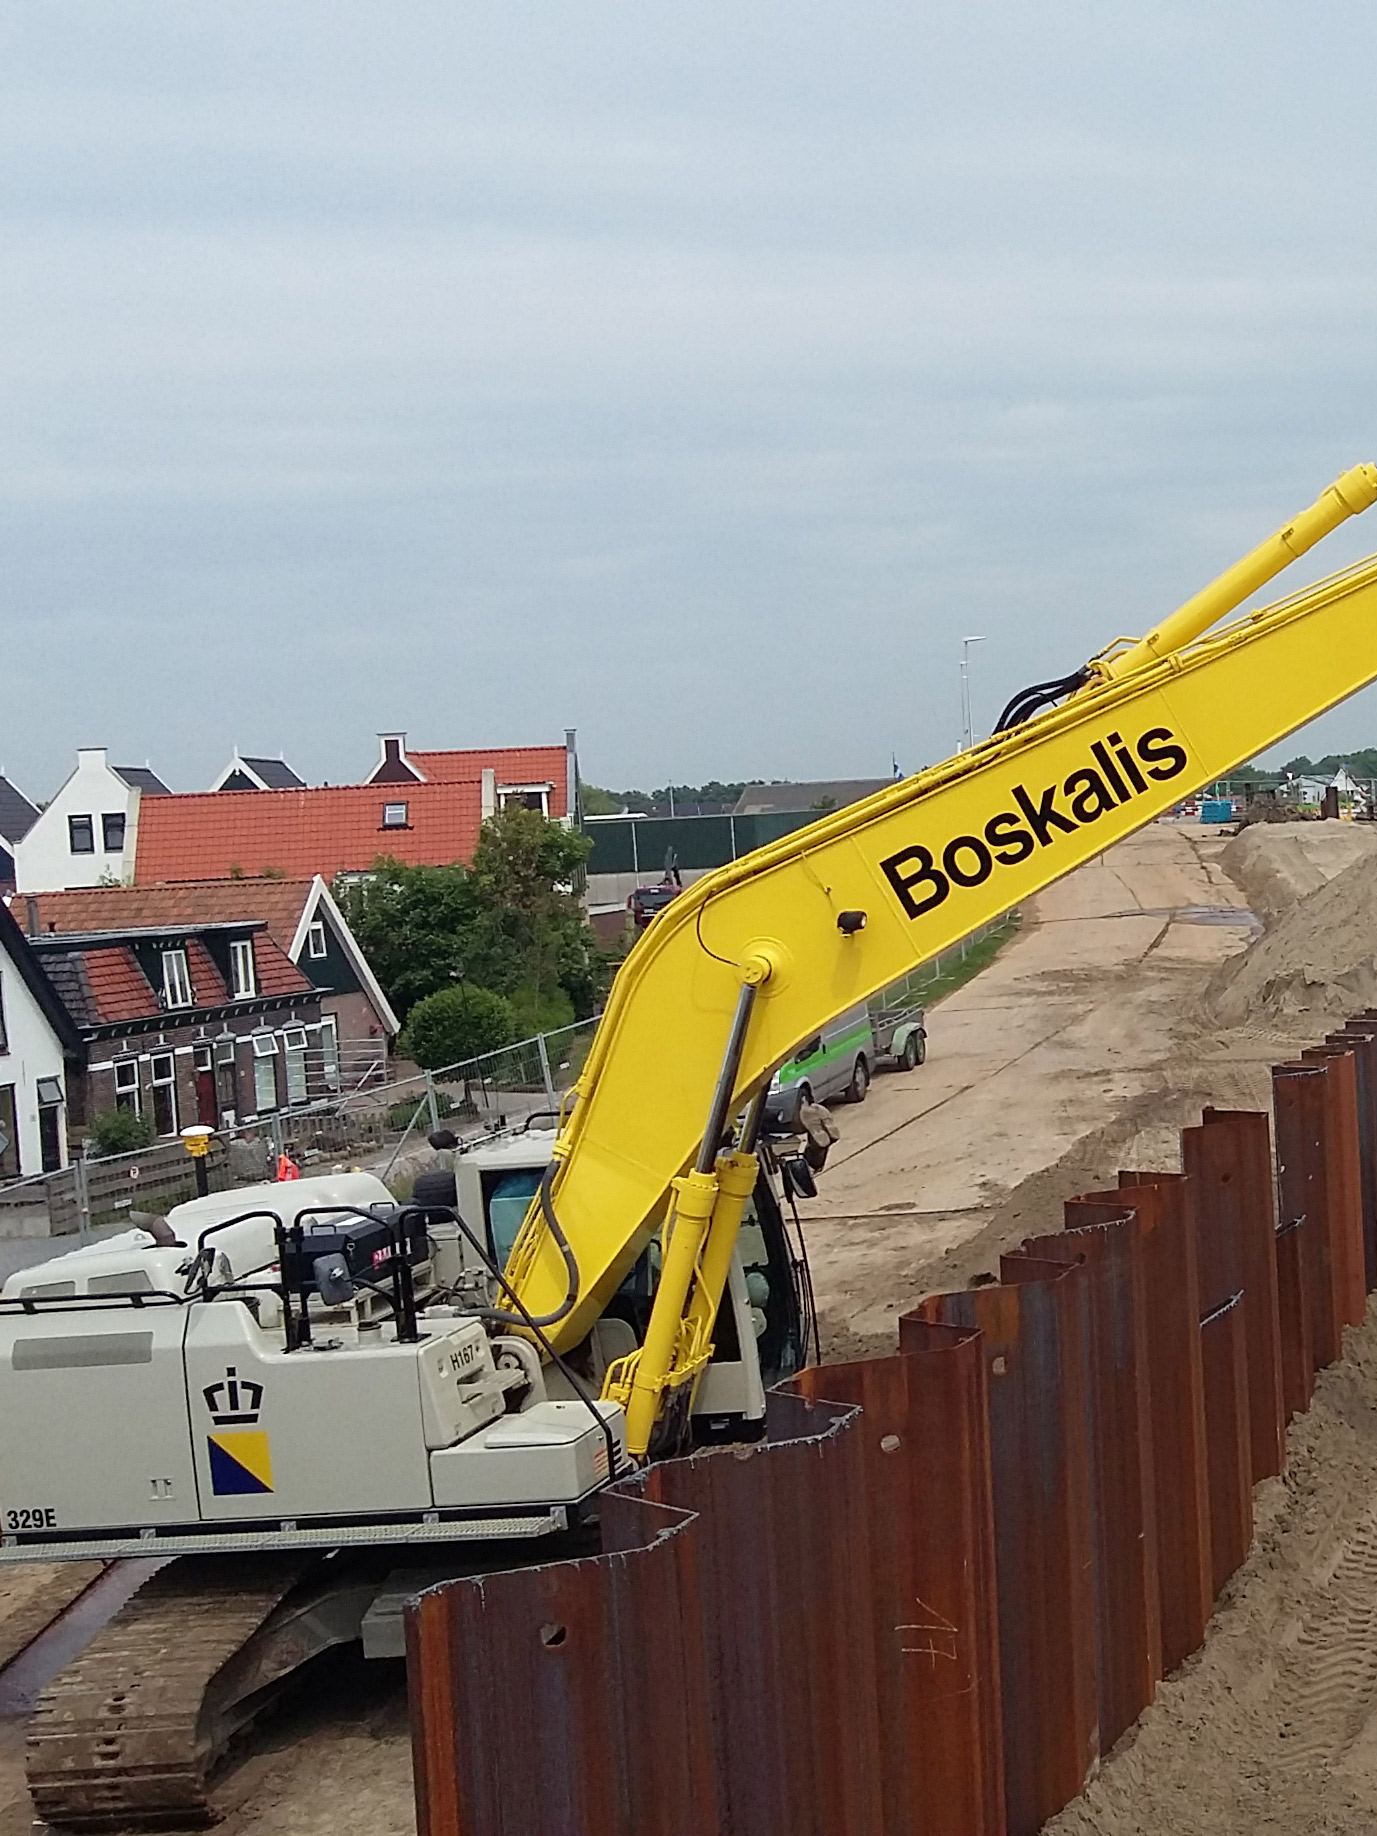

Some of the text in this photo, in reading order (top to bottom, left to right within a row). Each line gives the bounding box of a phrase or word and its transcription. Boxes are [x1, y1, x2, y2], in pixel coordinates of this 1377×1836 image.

[879, 726, 1188, 921] Boskalis
[449, 1344, 474, 1371] H167
[6, 1508, 57, 1530] 329E
